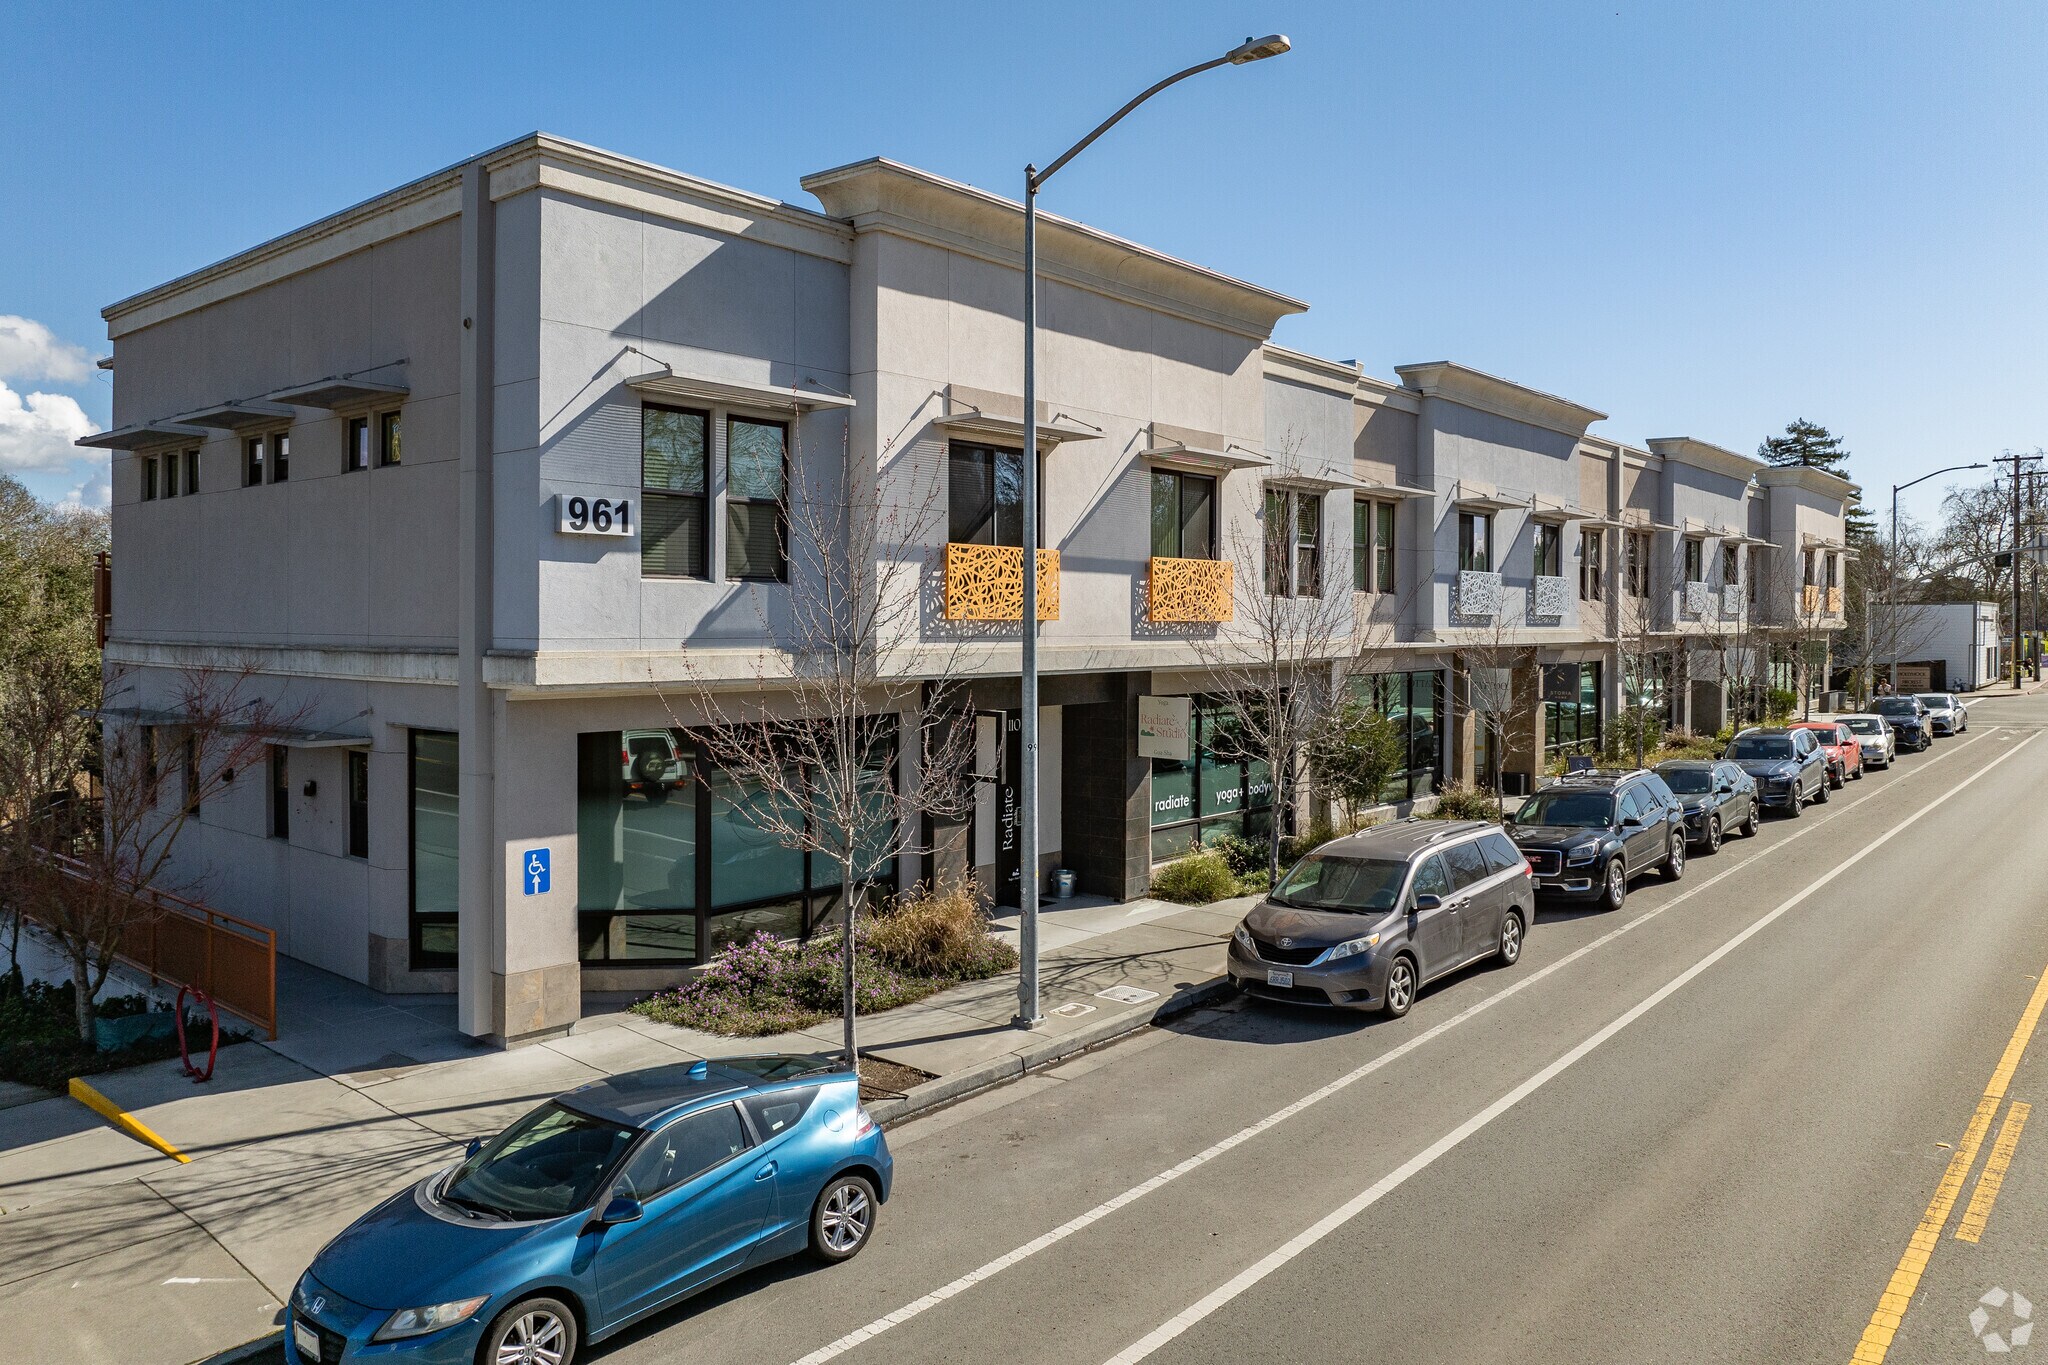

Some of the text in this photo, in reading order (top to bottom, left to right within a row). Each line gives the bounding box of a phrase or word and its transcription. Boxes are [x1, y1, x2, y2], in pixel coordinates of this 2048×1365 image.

[568, 496, 629, 533] 961
[1008, 718, 1021, 732] 110
[1141, 713, 1176, 727] Radiate
[1156, 727, 1187, 739] Studio
[1154, 794, 1190, 812] radiate
[1002, 785, 1014, 851] Radiate
